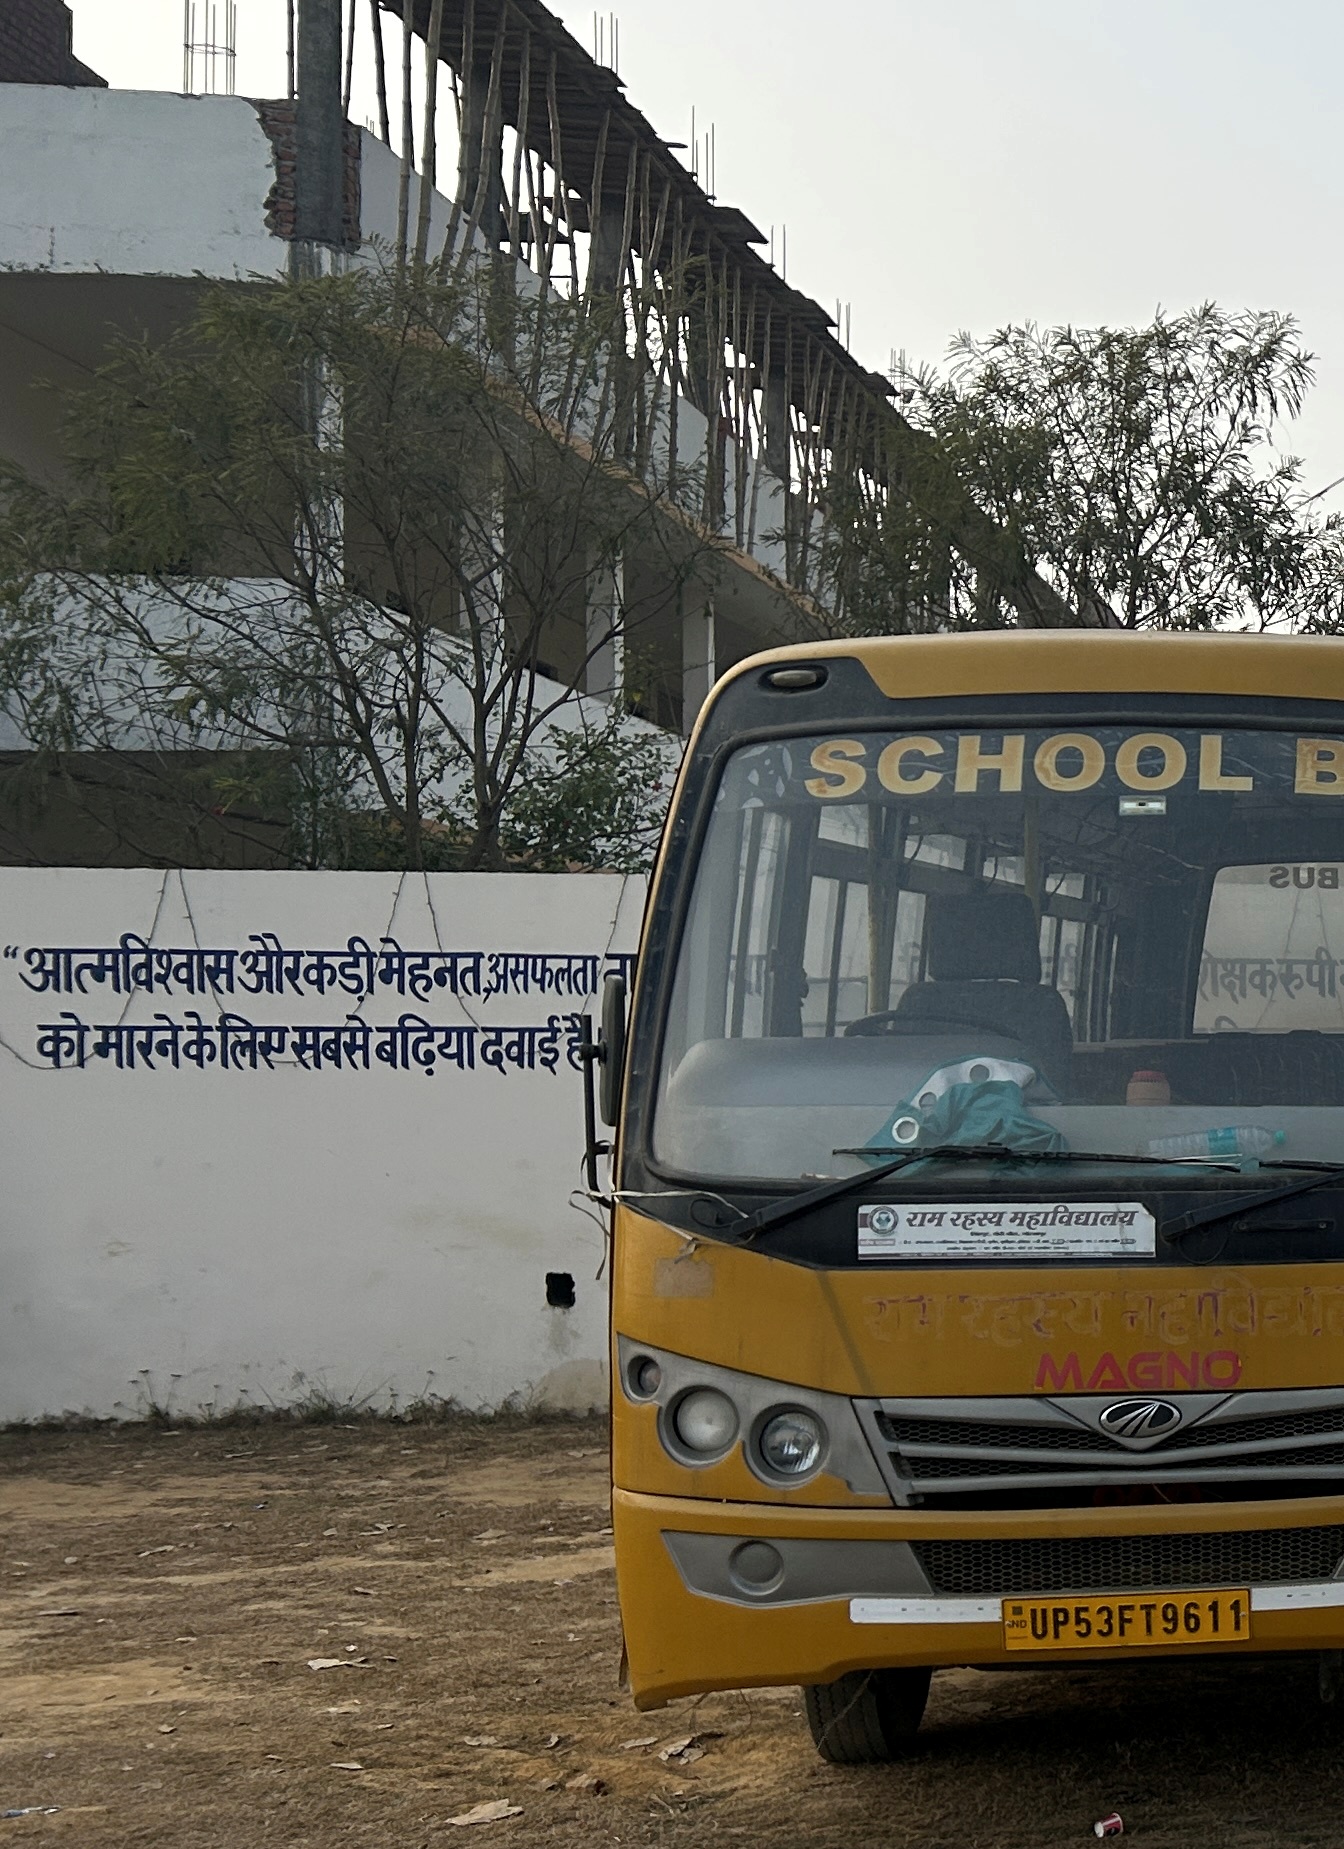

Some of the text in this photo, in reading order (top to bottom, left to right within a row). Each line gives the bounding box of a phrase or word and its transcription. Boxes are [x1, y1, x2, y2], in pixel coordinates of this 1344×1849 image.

[804, 731, 1255, 799] SCHOOL
[303, 936, 378, 1002] कड़ी
[486, 952, 600, 996] असफलता
[36, 1011, 91, 1069] को
[93, 1013, 185, 1070] मारने
[182, 1011, 217, 1069] के
[215, 1012, 290, 1070] लिए
[290, 1013, 375, 1070] सबसे
[374, 1013, 480, 1076] बढ़िया
[480, 1014, 563, 1076] दवाई
[904, 1204, 1139, 1230] राम रहस्य महाविद्यालय
[1034, 1350, 1243, 1391] MAGNO
[1030, 1599, 1242, 1640] UP53FT9611
